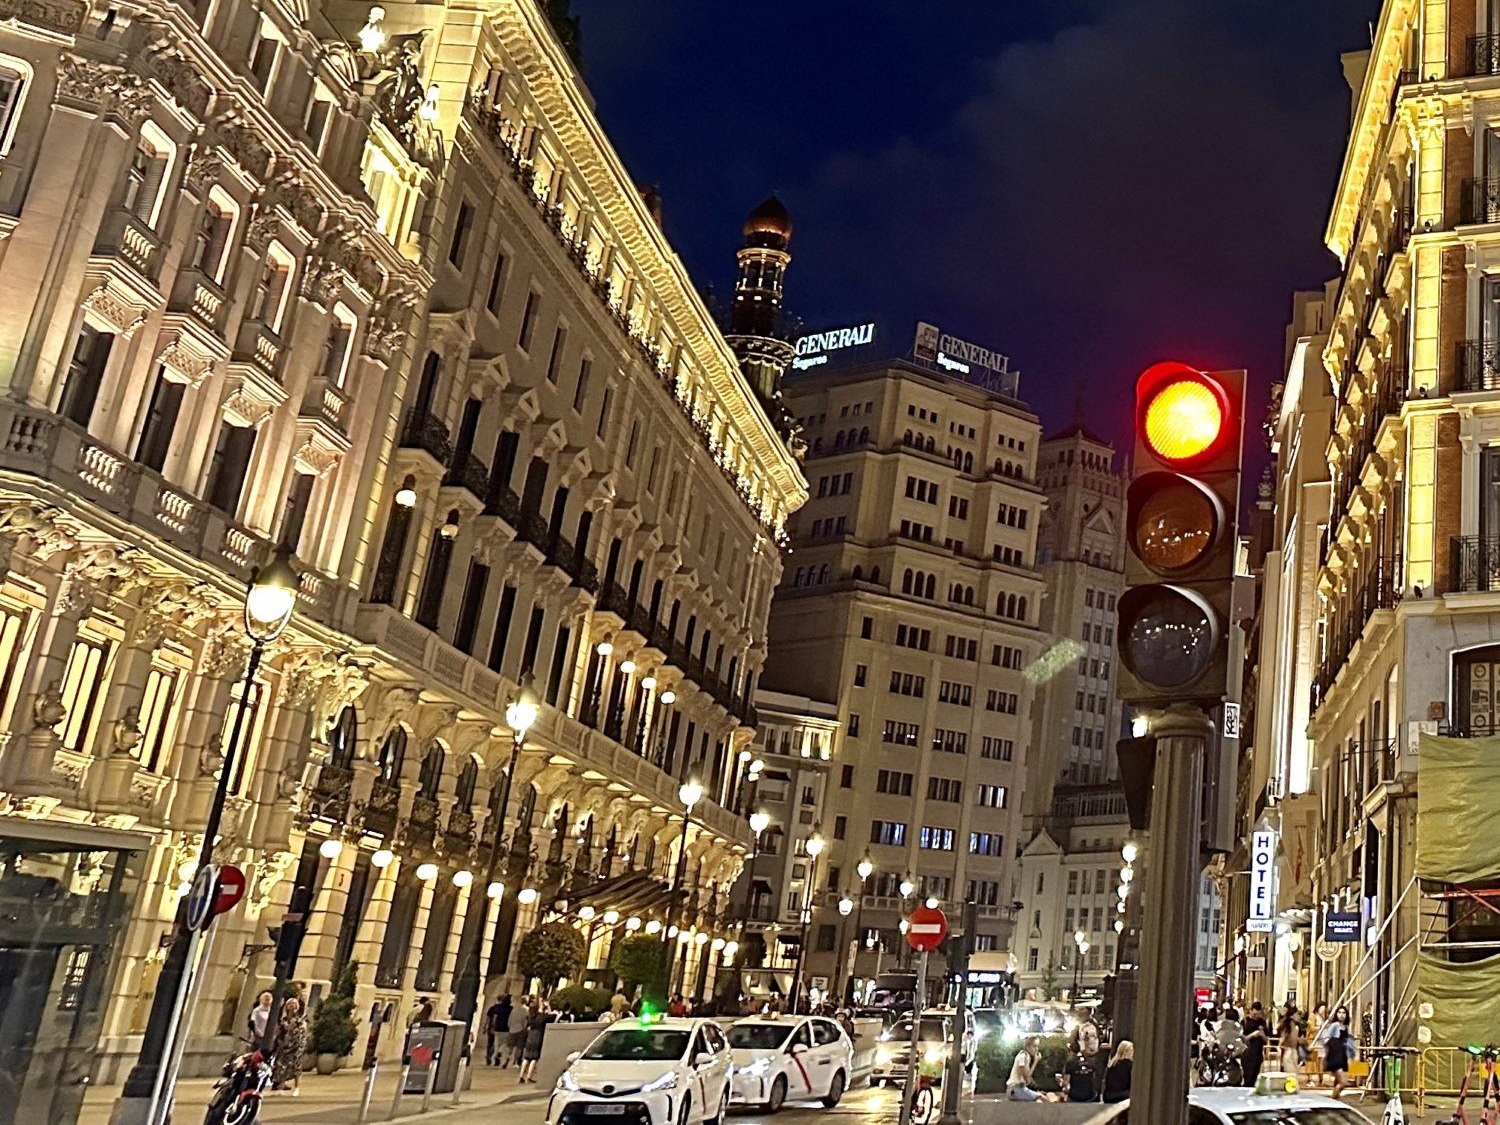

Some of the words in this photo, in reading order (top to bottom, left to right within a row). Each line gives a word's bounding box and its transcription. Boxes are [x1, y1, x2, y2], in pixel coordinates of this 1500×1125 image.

[796, 323, 875, 355] GENERALI
[940, 334, 1009, 374] GENERALI
[1256, 836, 1269, 916] HOTEL
[1327, 920, 1358, 928] CHANGE
